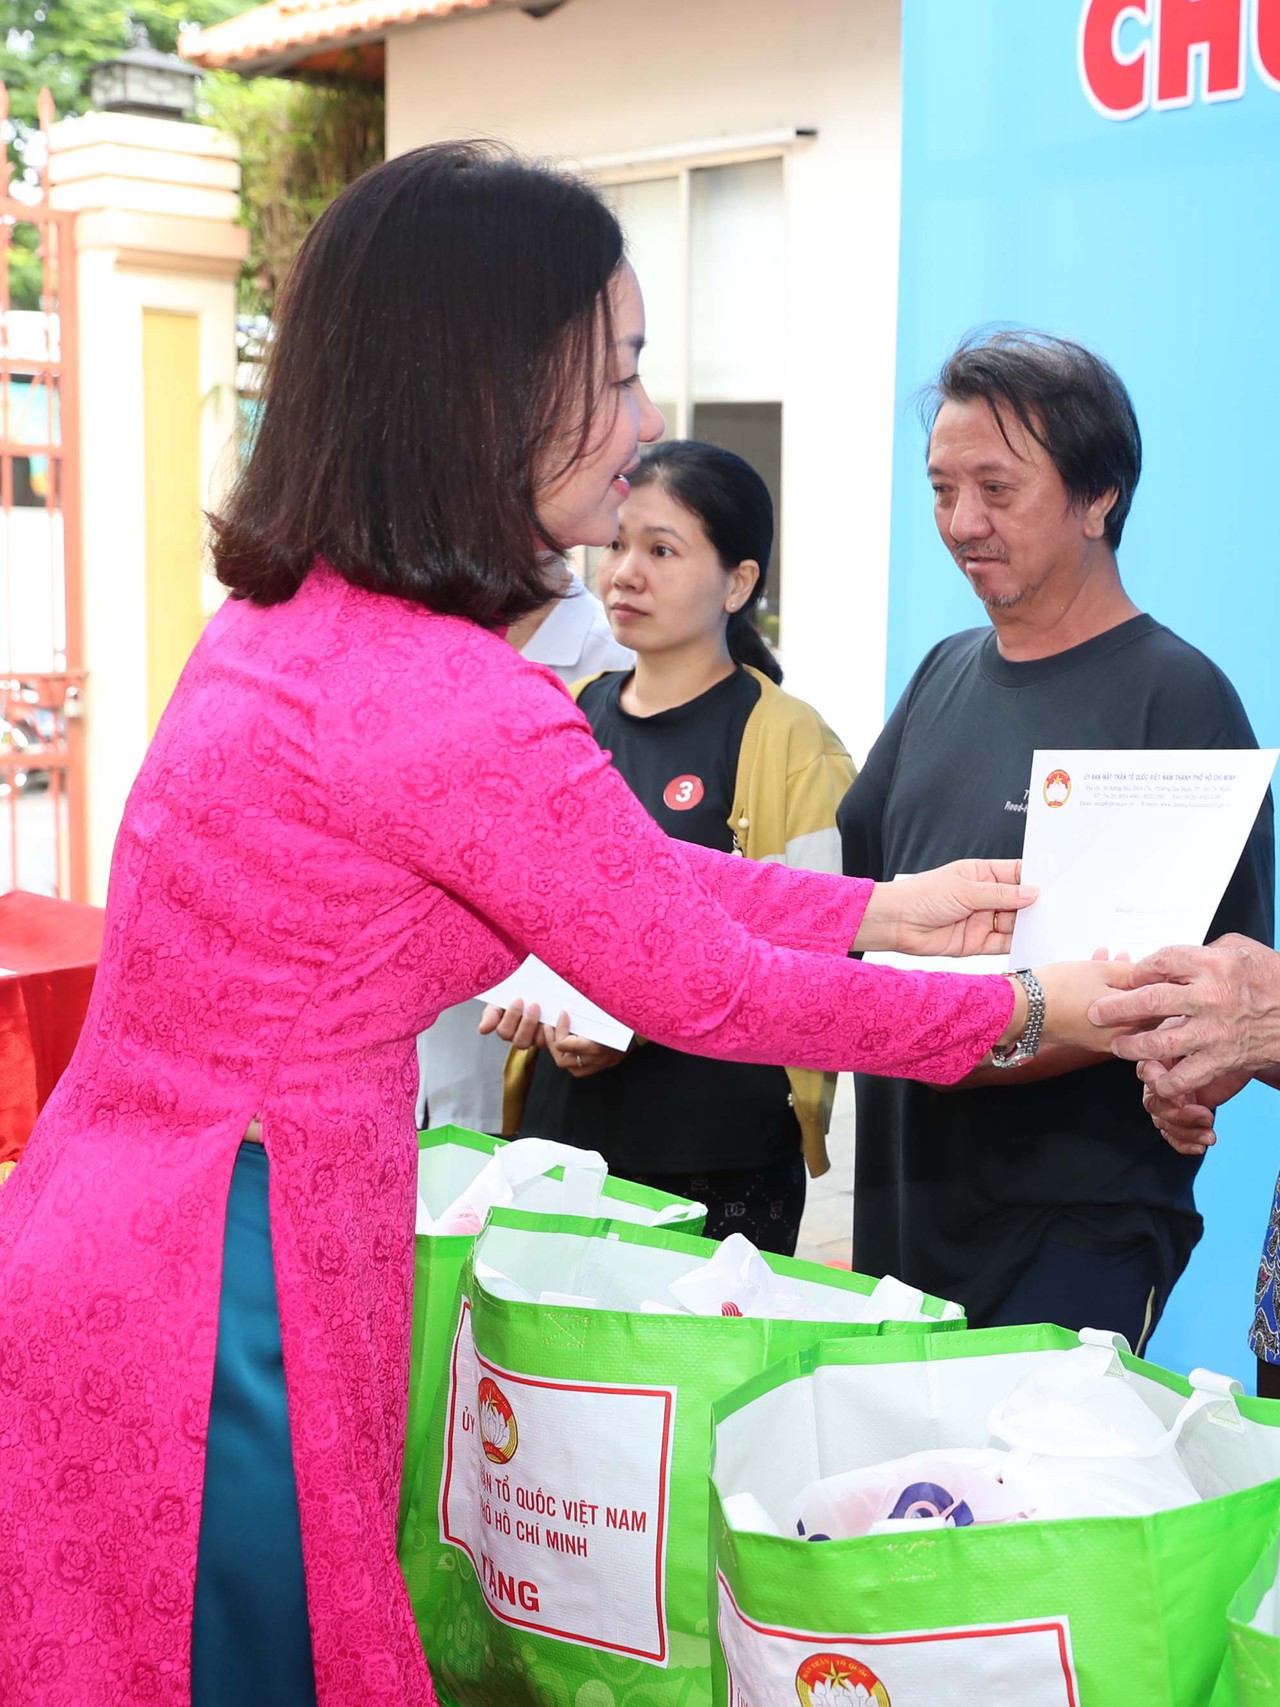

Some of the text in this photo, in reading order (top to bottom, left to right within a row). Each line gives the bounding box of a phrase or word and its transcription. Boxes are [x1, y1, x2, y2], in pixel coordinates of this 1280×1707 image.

[675, 781, 694, 802] 3
[462, 1405, 475, 1435] ỦY
[495, 1475, 510, 1503] TỔ
[516, 1487, 556, 1517] QUỐC
[562, 1499, 599, 1528] VIỆT
[606, 1507, 647, 1533] NAM
[495, 1508, 511, 1535] HỒ
[516, 1520, 540, 1545] CHÍ
[546, 1529, 587, 1557] MINH
[481, 1550, 539, 1612] TẶNG
